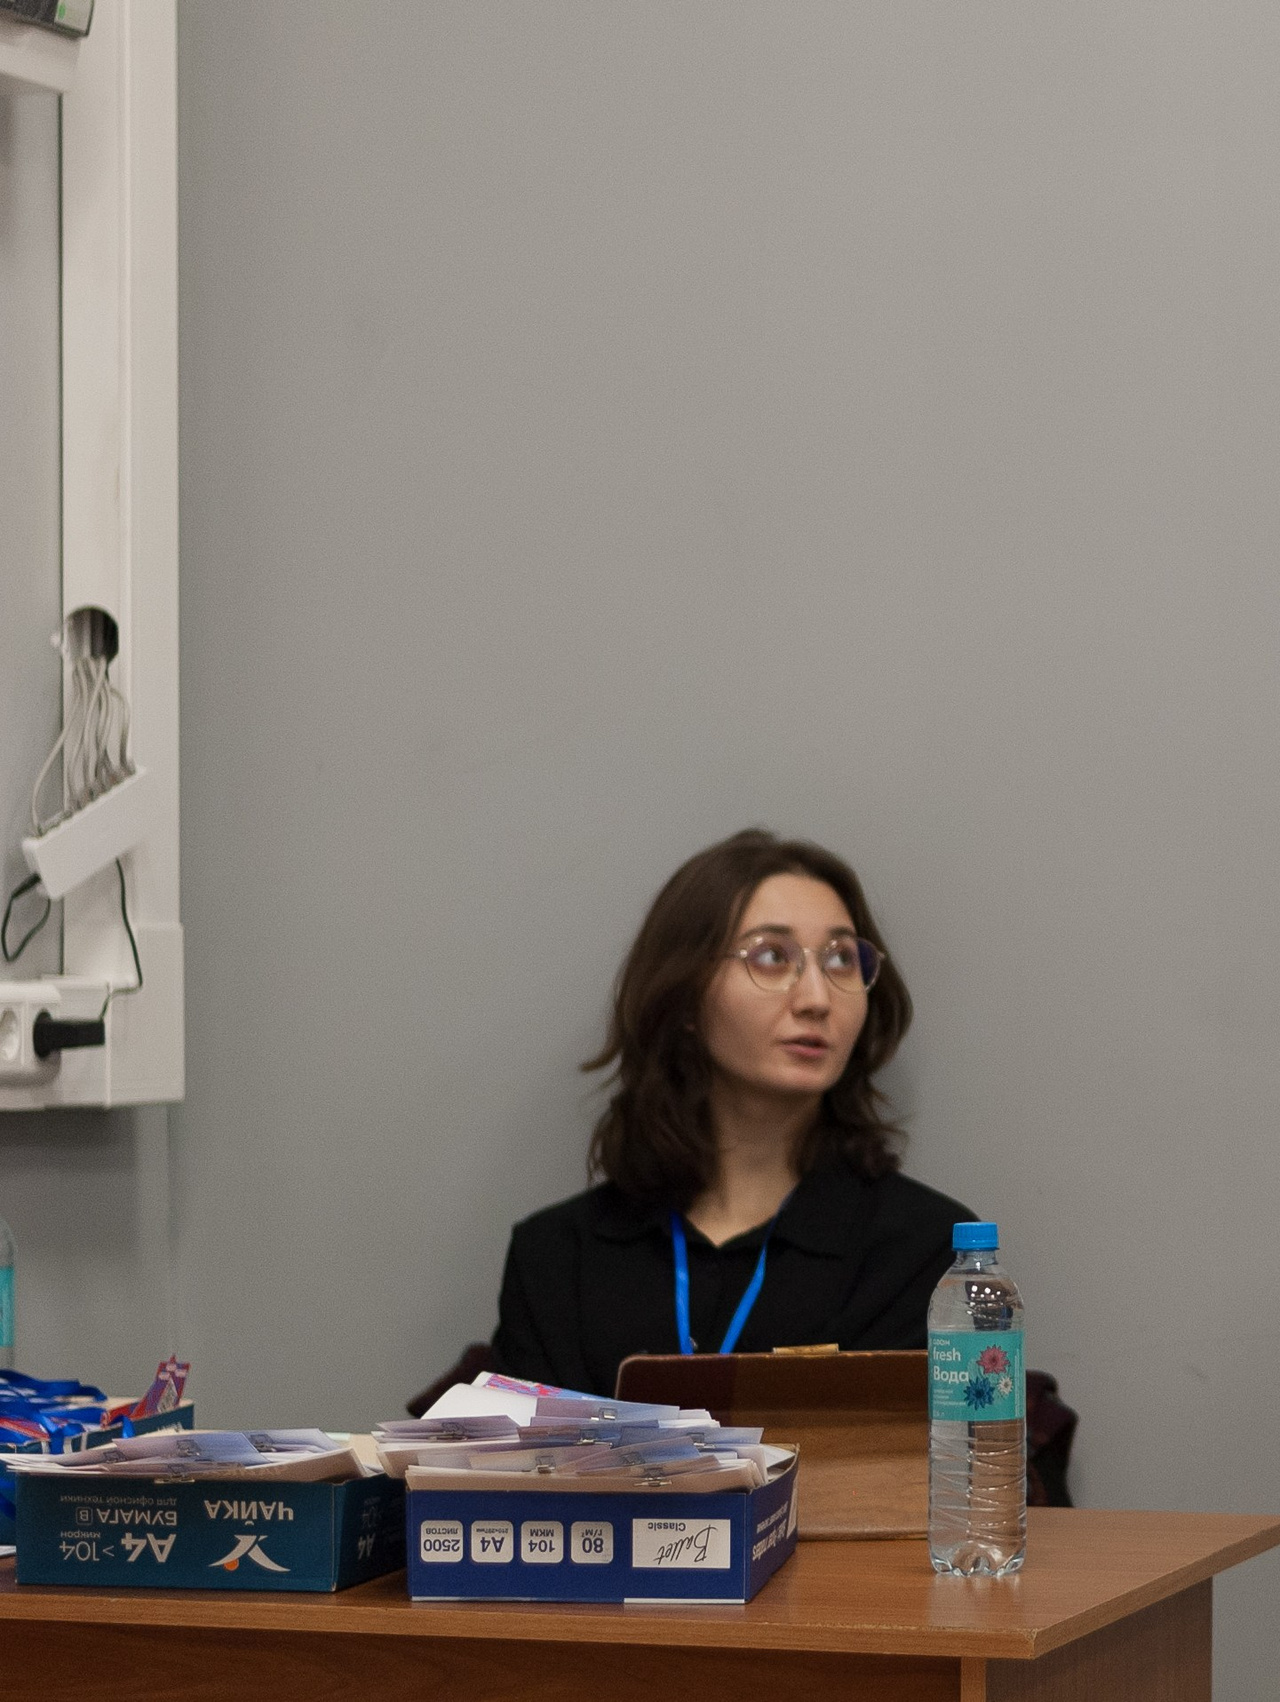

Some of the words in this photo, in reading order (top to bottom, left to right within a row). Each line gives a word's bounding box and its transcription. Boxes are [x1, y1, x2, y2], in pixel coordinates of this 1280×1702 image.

[933, 1346, 961, 1361] fresh
[933, 1365, 969, 1384] Вода
[59, 1494, 104, 1505] техники
[97, 1508, 177, 1525] БУМАГА
[204, 1500, 294, 1527] ЧАЙКА
[647, 1521, 686, 1532] Classic
[60, 1530, 101, 1540] микрон
[423, 1539, 461, 1552] 2500
[528, 1540, 556, 1554] 104
[582, 1538, 604, 1553] 80
[652, 1524, 717, 1565] Ballet
